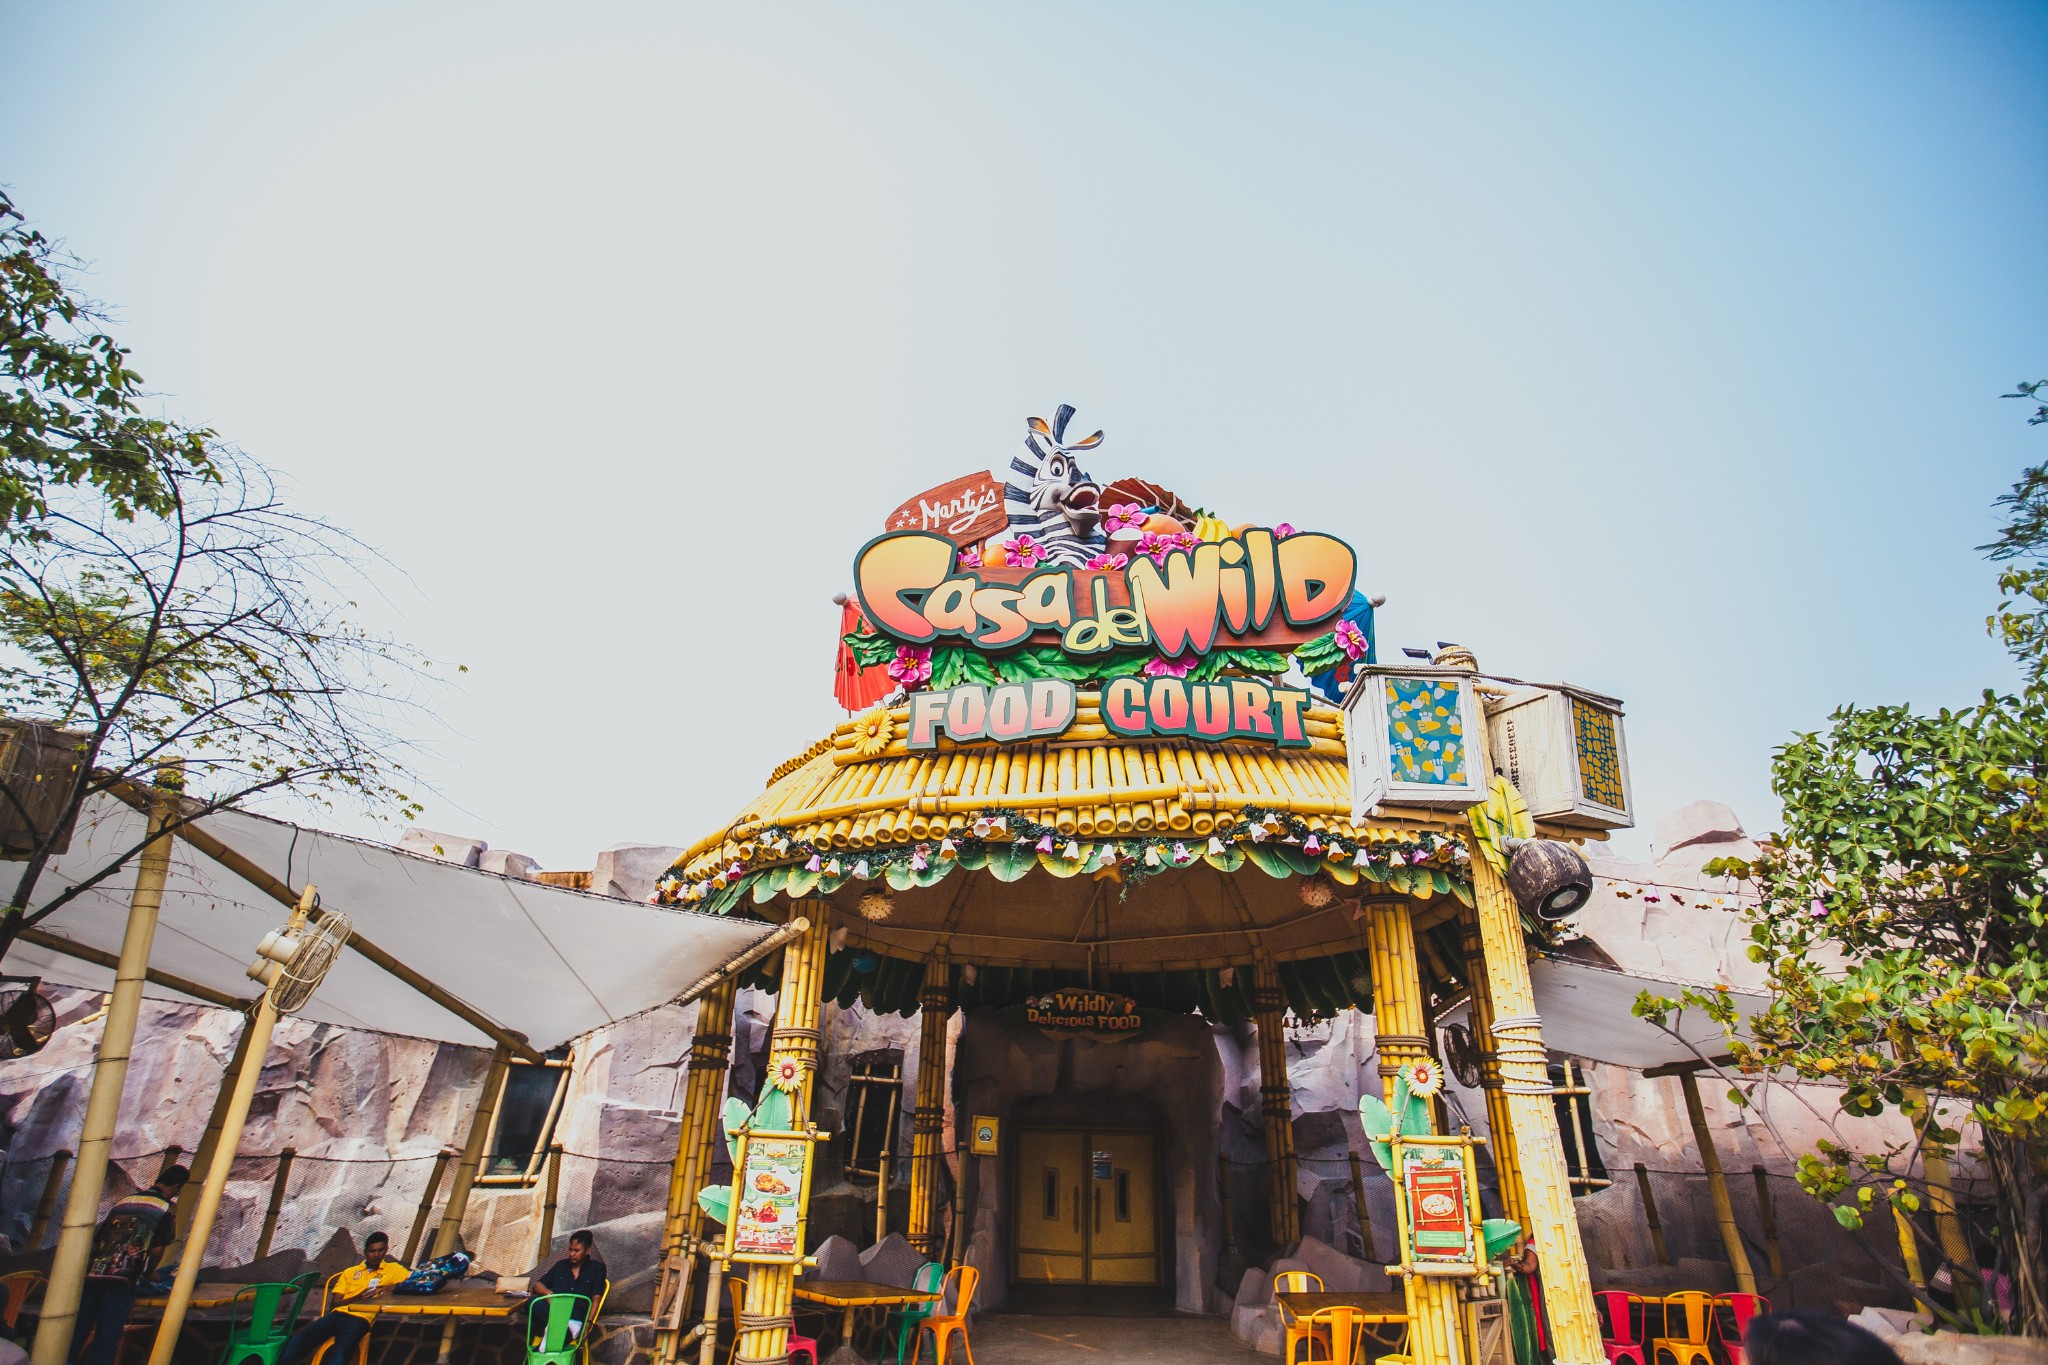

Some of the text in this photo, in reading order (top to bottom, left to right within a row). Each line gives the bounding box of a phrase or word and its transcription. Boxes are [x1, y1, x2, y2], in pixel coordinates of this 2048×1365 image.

[918, 484, 999, 535] Marty's
[857, 532, 1073, 647] Casa
[1065, 575, 1149, 653] del
[911, 676, 1308, 747] FOOD COURT
[1056, 993, 1114, 1015] Wildly
[1098, 1015, 1141, 1030] FOOD
